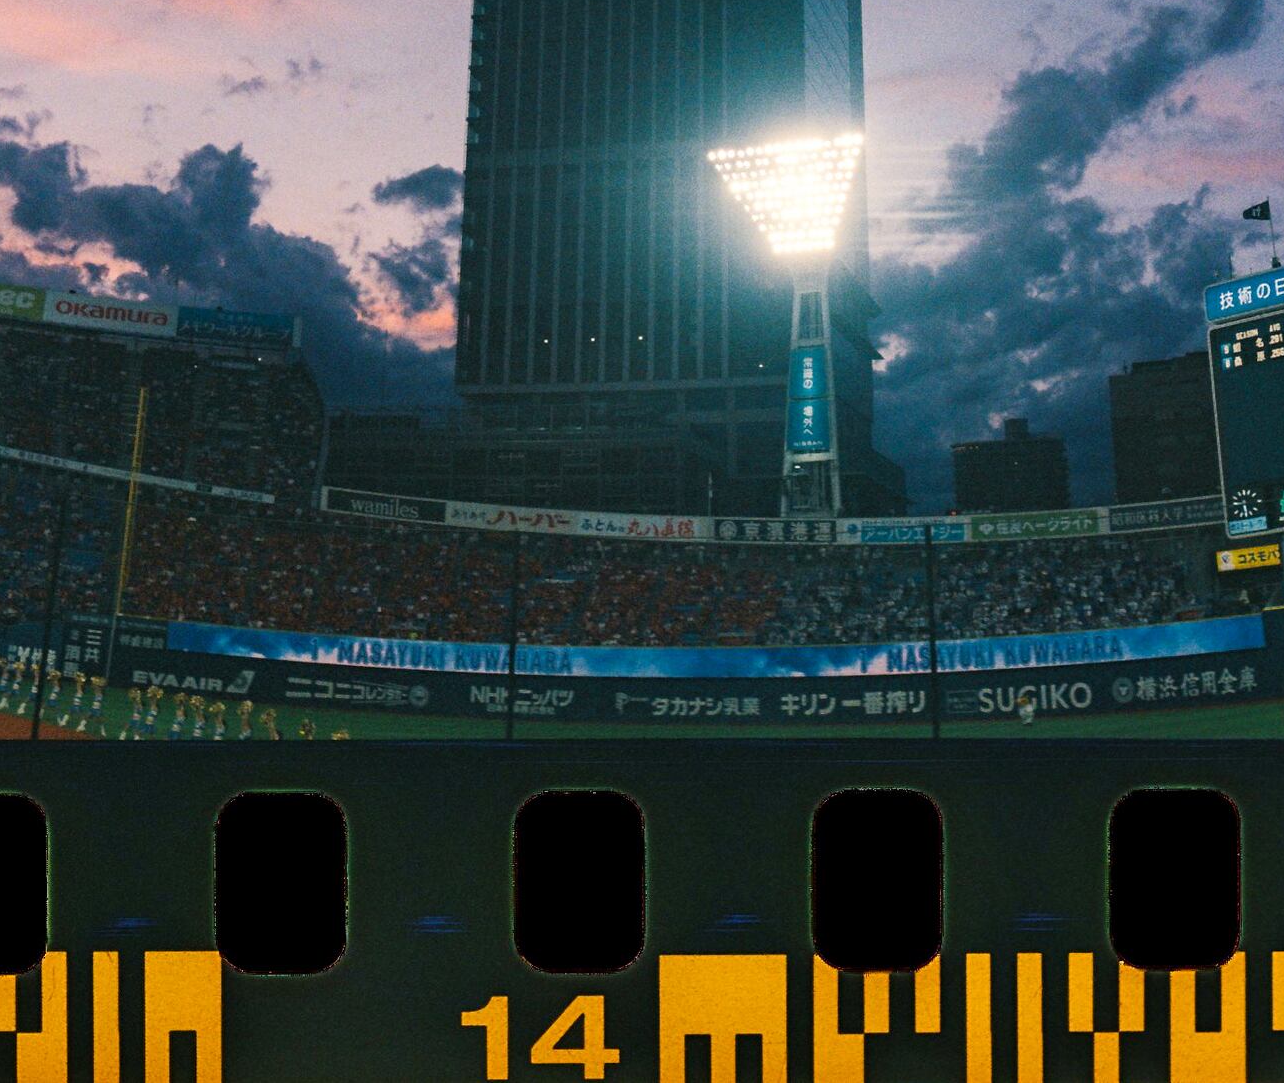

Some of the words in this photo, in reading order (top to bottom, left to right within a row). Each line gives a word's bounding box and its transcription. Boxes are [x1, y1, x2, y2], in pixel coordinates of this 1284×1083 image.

[350, 494, 420, 519] wamiles
[337, 641, 446, 669] MASAYUKI
[454, 648, 574, 675] KUWAHARA
[1004, 634, 1120, 669] KUWAHARA
[514, 689, 574, 707] ニッパツ
[977, 682, 1093, 713] SUGIKO
[1135, 666, 1258, 702] 横浜信用金庫
[651, 696, 761, 716] タカナシ乳業
[780, 690, 926, 716] キリン一番搾り
[460, 995, 620, 1081] 14
